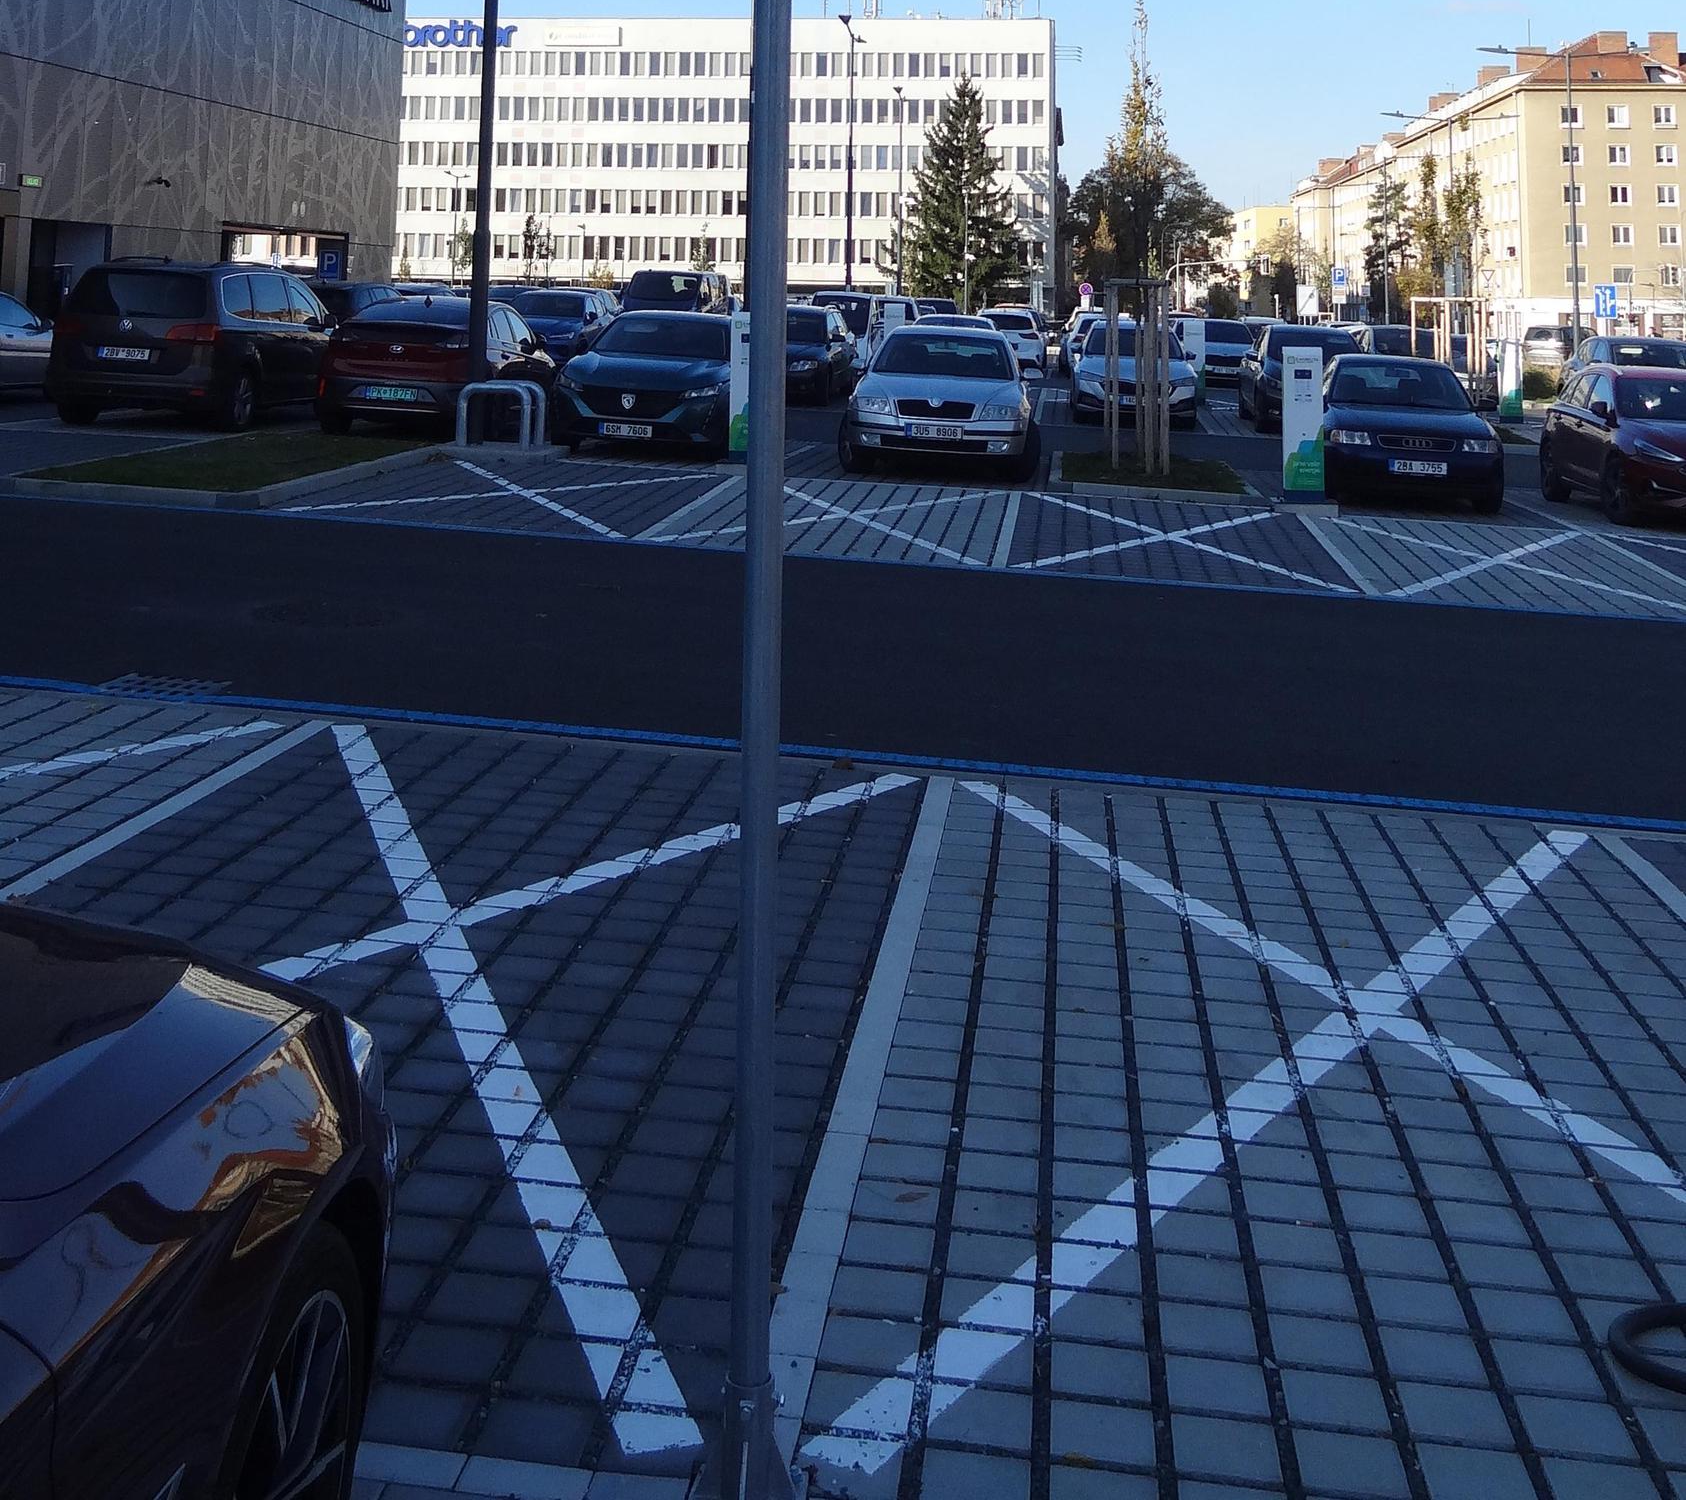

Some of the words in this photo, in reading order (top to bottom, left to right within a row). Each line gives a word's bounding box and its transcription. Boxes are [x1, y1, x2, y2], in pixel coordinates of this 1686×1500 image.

[403, 20, 517, 48] brothr
[324, 253, 336, 271] P
[1335, 269, 1344, 283] P
